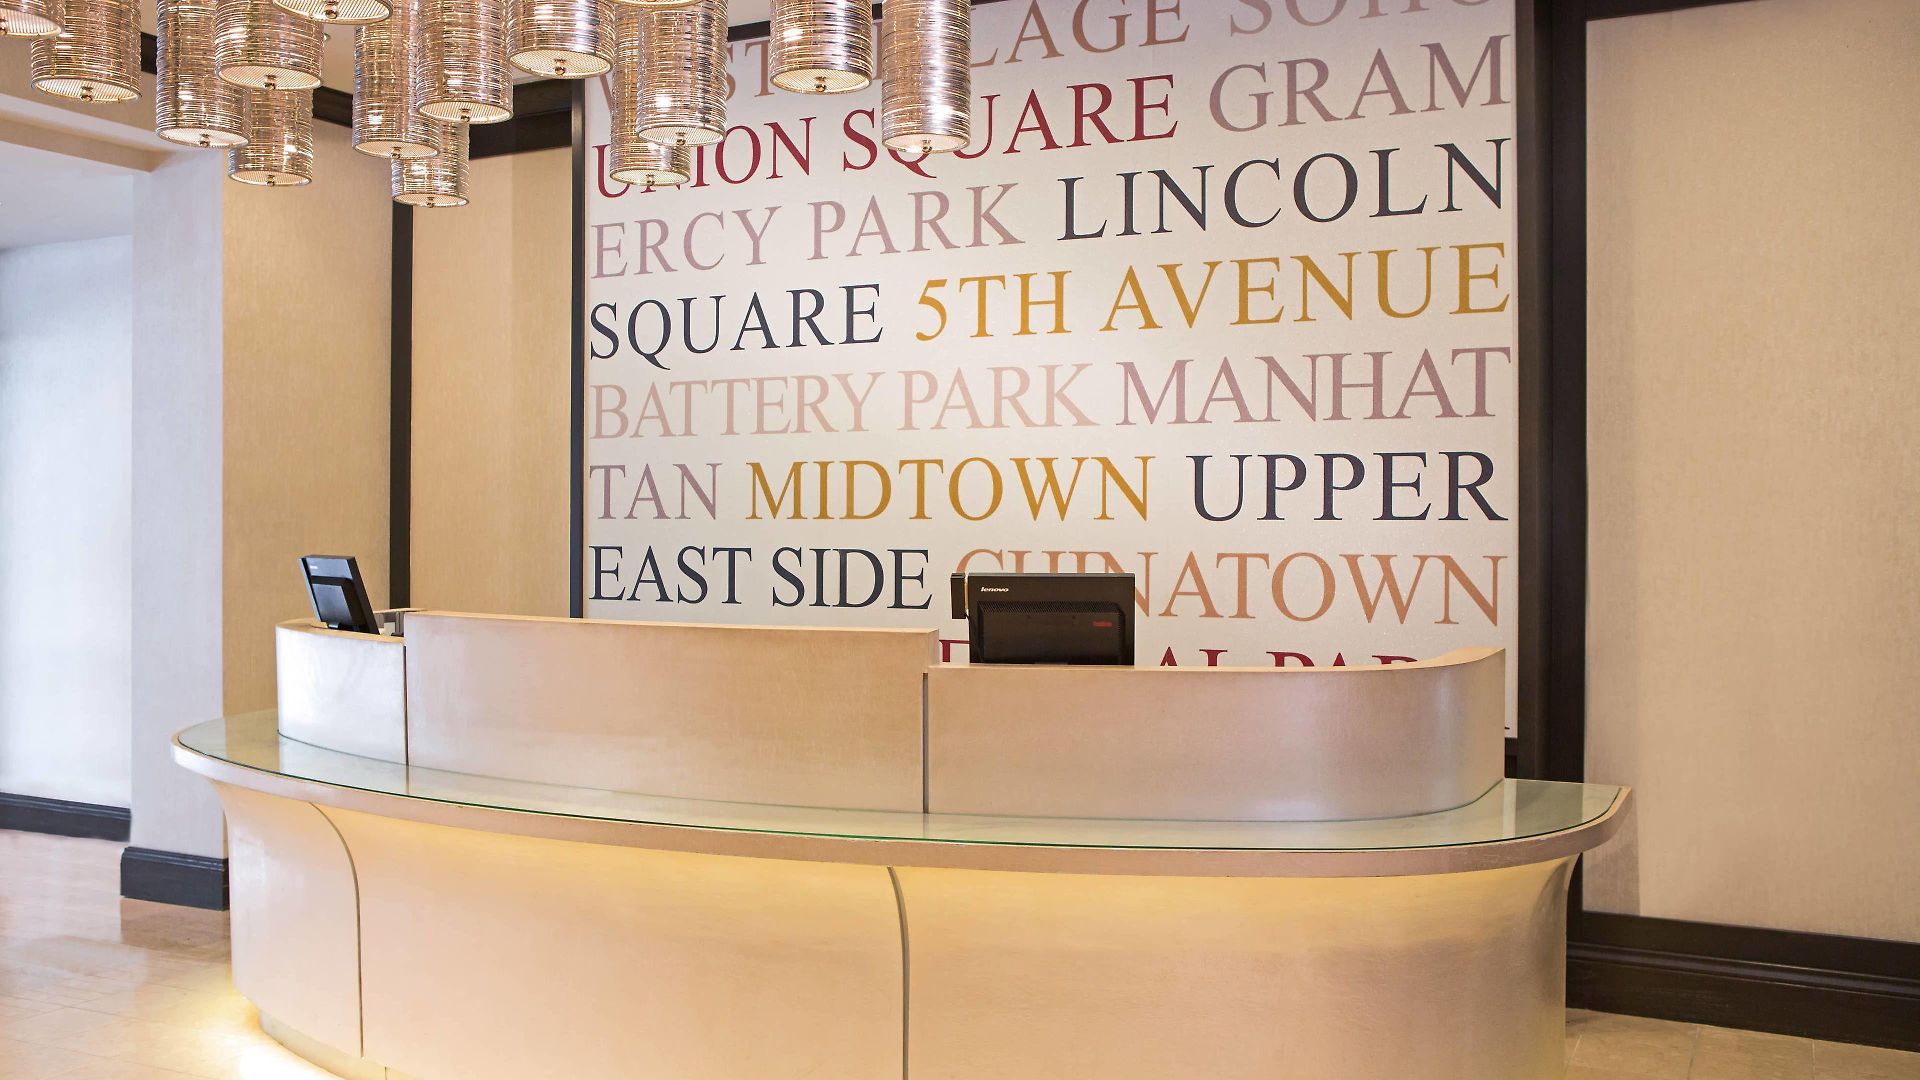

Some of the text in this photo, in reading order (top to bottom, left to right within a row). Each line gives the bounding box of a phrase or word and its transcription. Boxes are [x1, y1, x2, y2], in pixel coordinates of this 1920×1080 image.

[592, 116, 817, 199] UION
[1209, 34, 1511, 133] GRAM
[591, 138, 1511, 280] ERCY PARK LINCOLN
[590, 242, 1511, 371] SQUARE 5TH AVENUE
[590, 347, 1511, 440] BATTERY PARK MANHAT
[589, 451, 1509, 522] TAN MIDTOWN UPPER
[588, 545, 753, 605] EAST
[771, 547, 933, 610] SIDE
